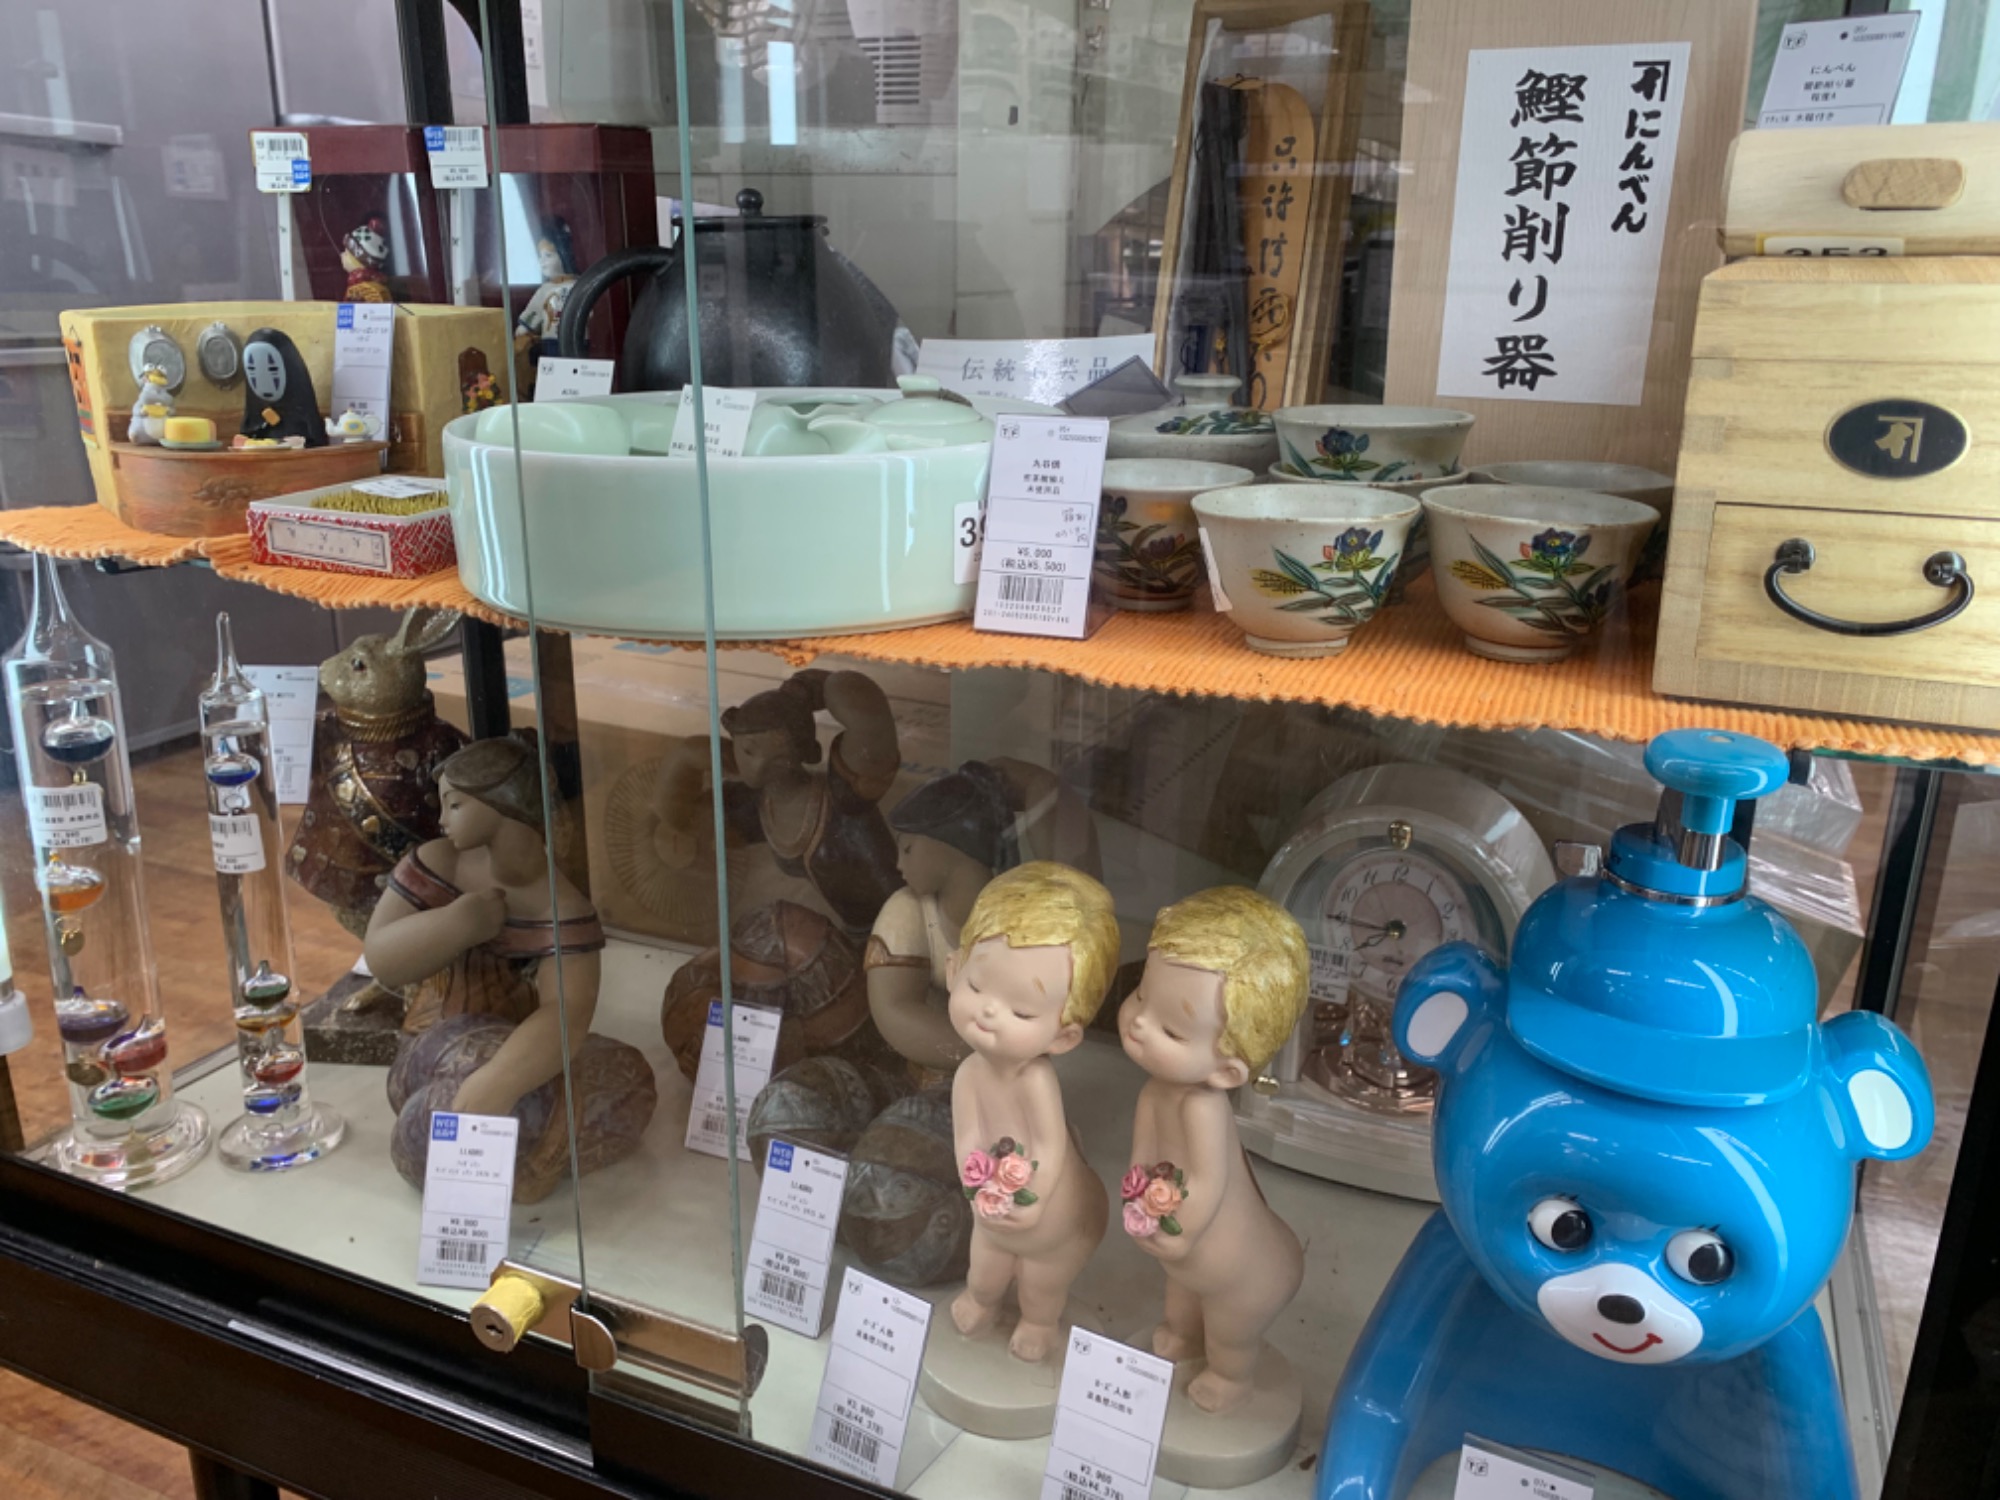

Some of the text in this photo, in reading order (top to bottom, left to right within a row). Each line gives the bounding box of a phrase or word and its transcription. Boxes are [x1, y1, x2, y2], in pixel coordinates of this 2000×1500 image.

[1810, 64, 1855, 75] にんべん
[1611, 109, 1661, 233] にんべん
[1482, 68, 1588, 391] 鰹節削り器
[962, 357, 1110, 382] 伝統芸品
[1017, 547, 1053, 558] ¥5,000
